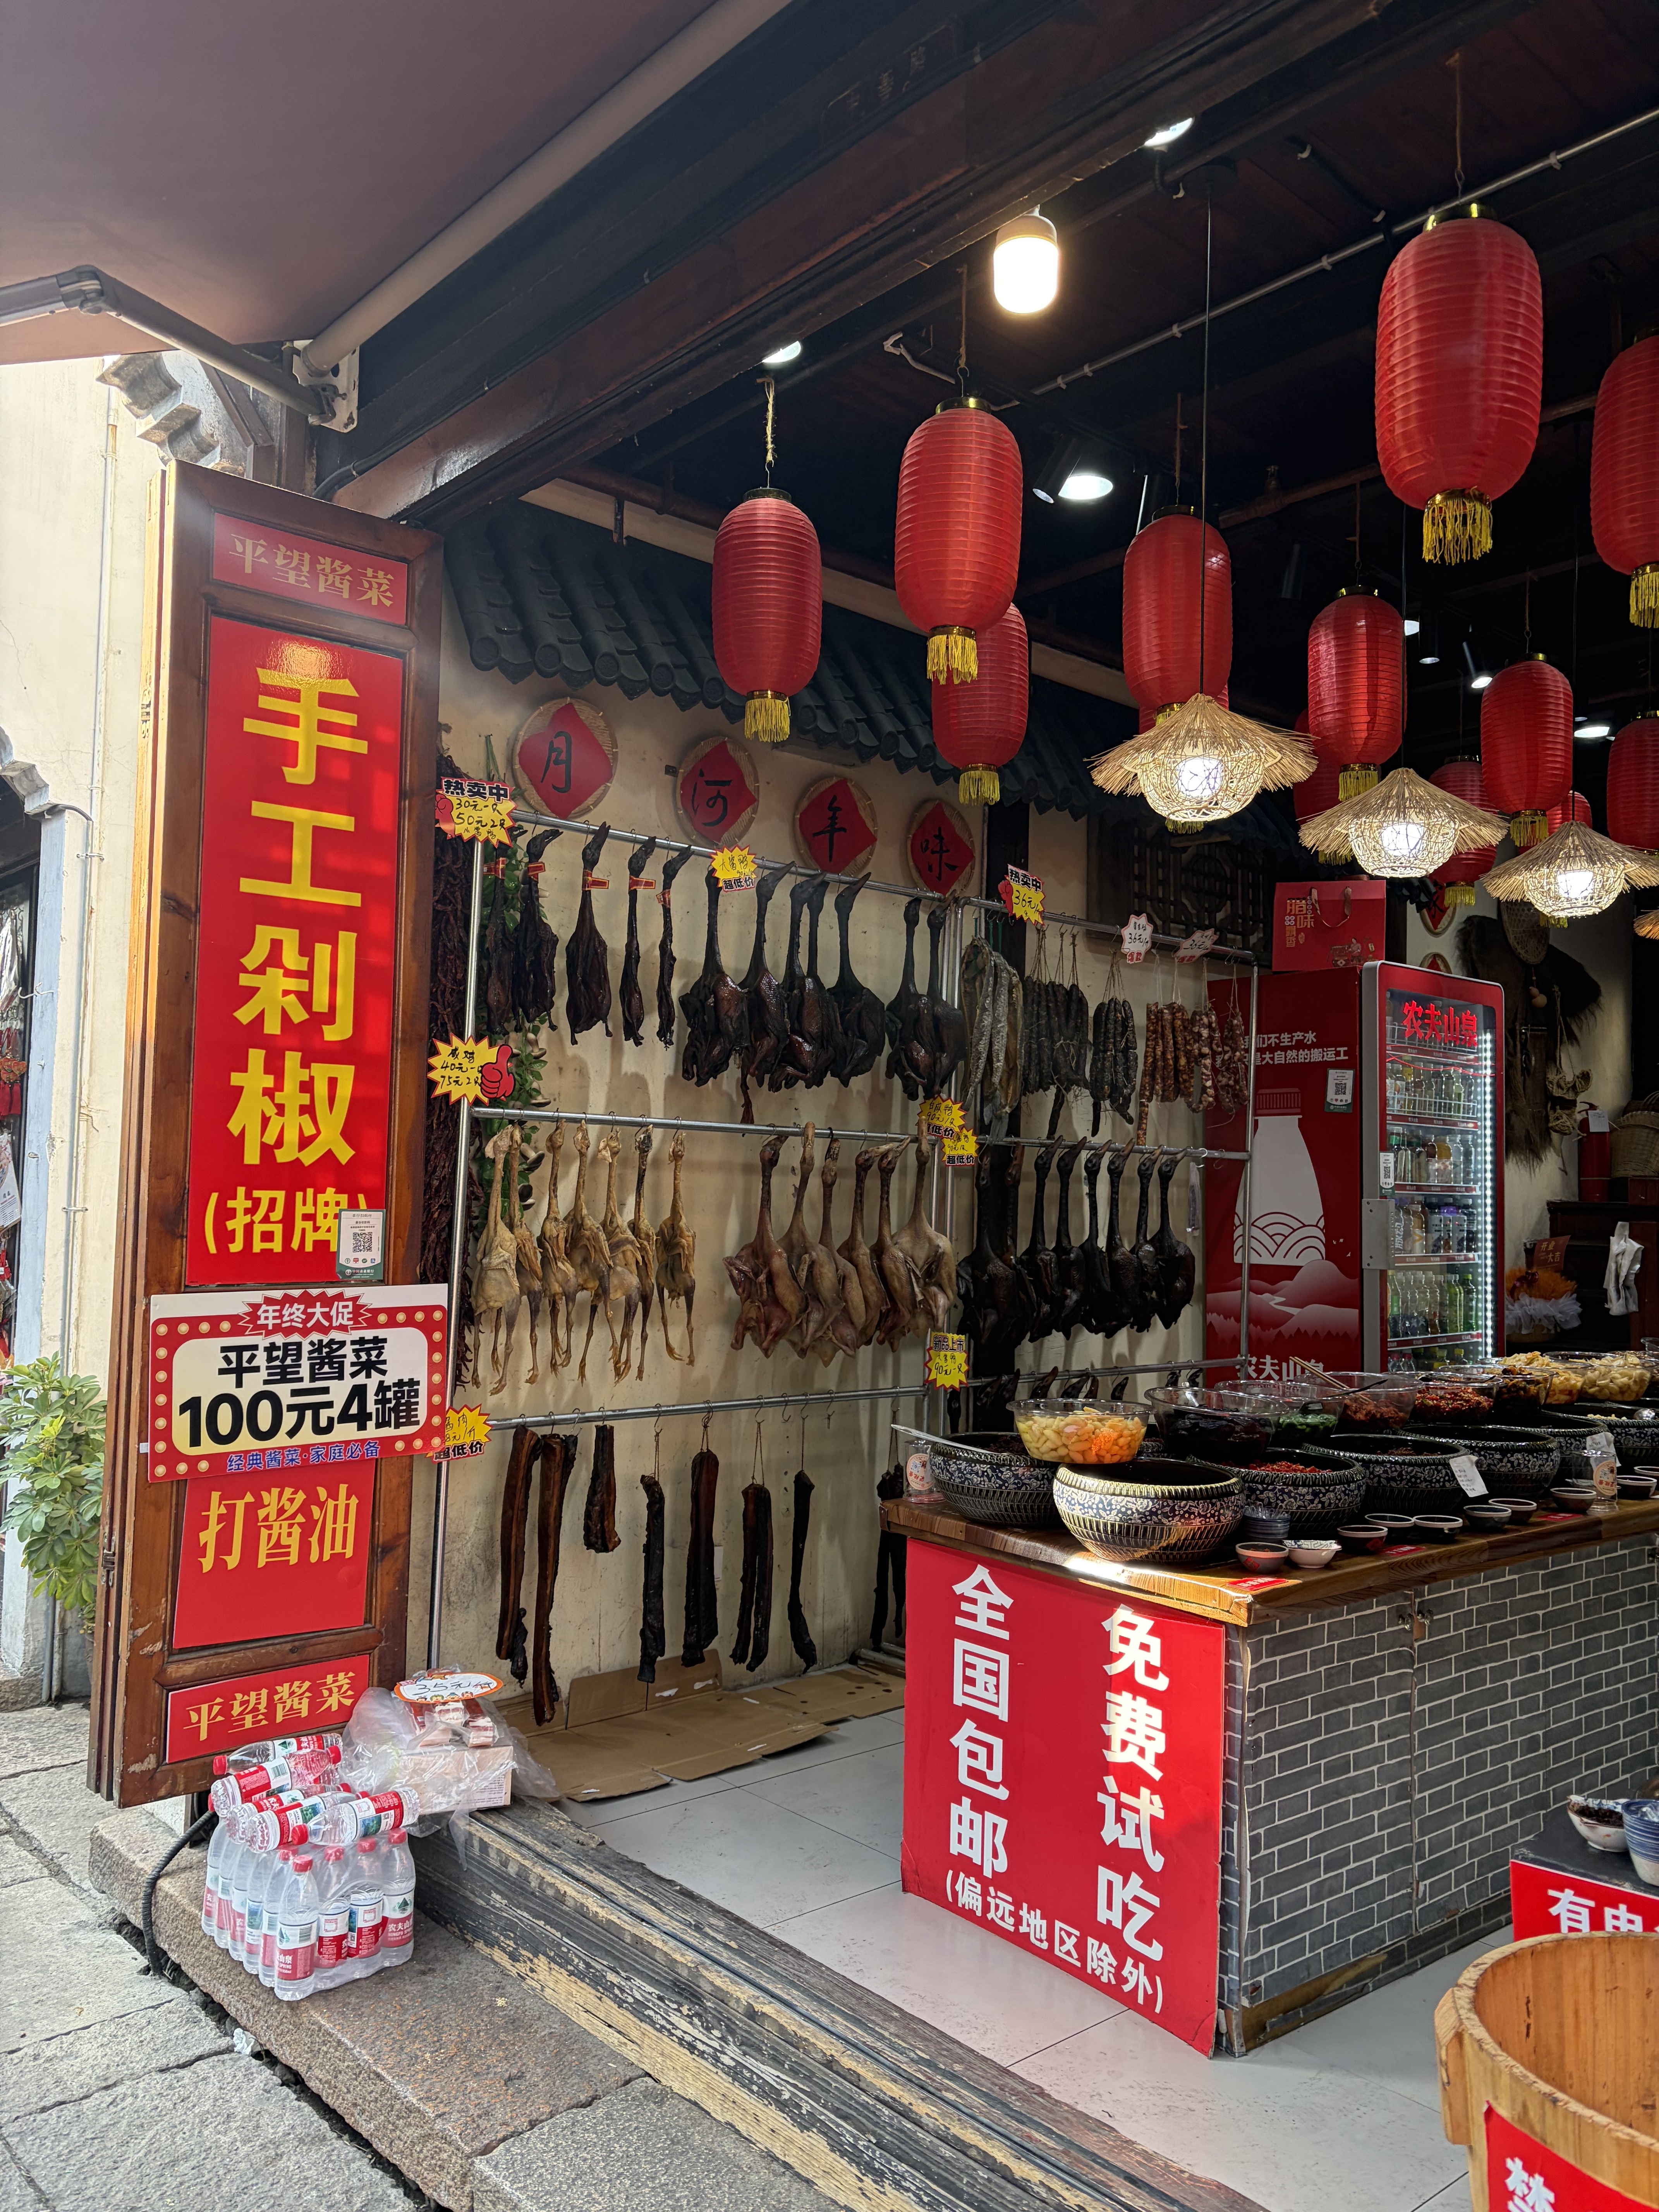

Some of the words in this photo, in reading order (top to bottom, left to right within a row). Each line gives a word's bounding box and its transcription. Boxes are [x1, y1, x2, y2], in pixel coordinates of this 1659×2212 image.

[229, 534, 393, 607] 平望酱菜
[444, 780, 508, 802] 热卖中
[541, 731, 572, 794] 月
[692, 769, 733, 827] 河
[812, 795, 847, 862] 年
[921, 826, 957, 881] 味
[723, 876, 754, 890] 超低价
[1009, 868, 1041, 892] 热卖中
[227, 667, 368, 1166] 手工剁椒
[1403, 1000, 1478, 1047] 农夫山泉
[1215, 1047, 1348, 1068] 是大自然的搬运工
[927, 1123, 955, 1138] 低价
[946, 1155, 974, 1164] 超低价
[205, 1186, 367, 1254] (招牌
[1547, 1252, 1561, 1262] 大吉
[257, 1300, 354, 1331] 年终大促
[218, 1336, 388, 1389] 平望酱菜
[933, 1335, 964, 1352] 新品上市
[179, 1378, 421, 1448] 100元4罐
[198, 1484, 359, 1573] 打酱油
[183, 1671, 356, 1741] 平望酱菜
[948, 1563, 1014, 1879] 全国包邮
[1096, 1603, 1170, 1962] 免费试吃
[1547, 1888, 1659, 1932] 有电
